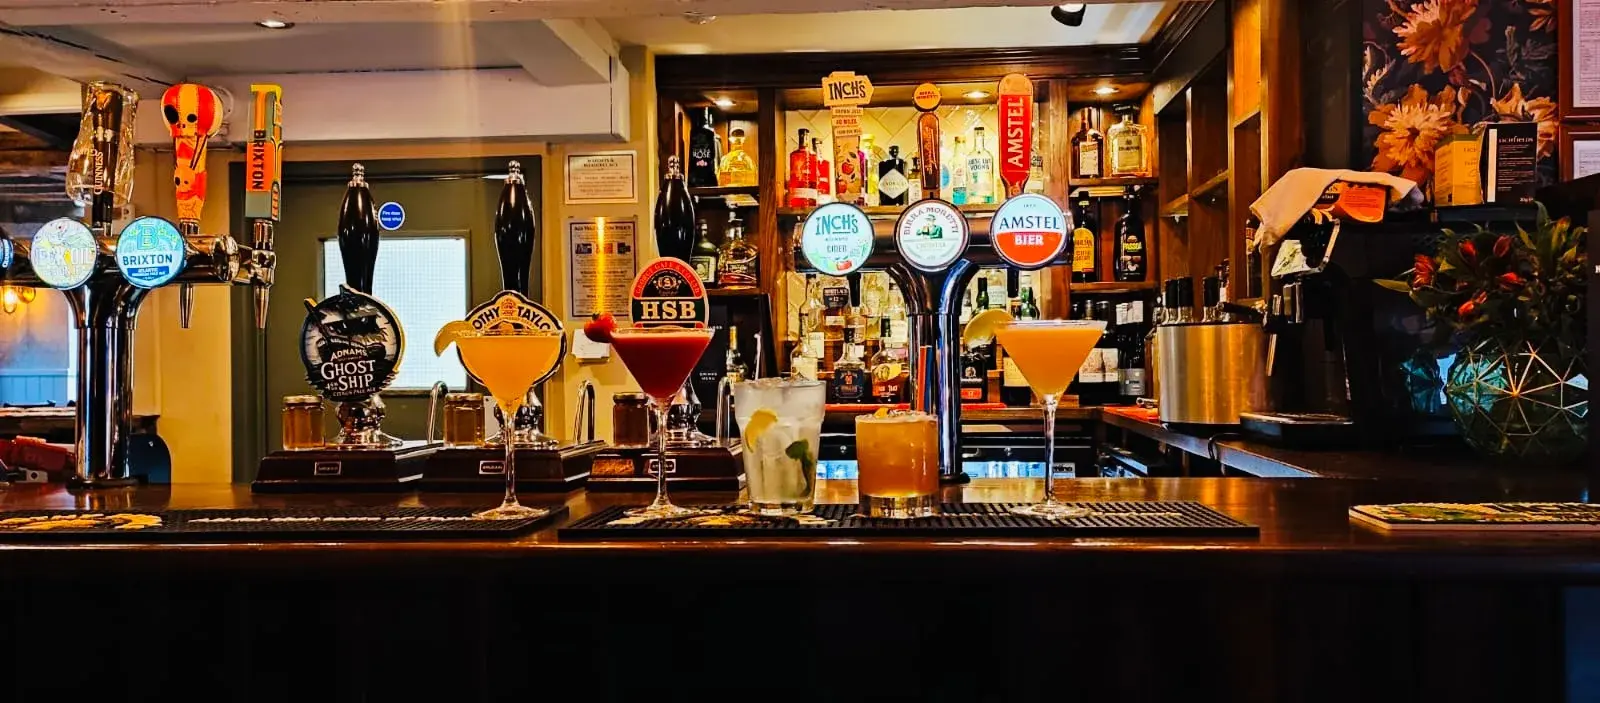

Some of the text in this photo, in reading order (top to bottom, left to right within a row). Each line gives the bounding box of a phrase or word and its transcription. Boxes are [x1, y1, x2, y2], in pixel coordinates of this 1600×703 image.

[1008, 96, 1024, 168] AMSTEL
[252, 130, 266, 189] BRIXTON
[93, 151, 104, 195] GUINNESS
[926, 207, 959, 233] MORETTI
[999, 216, 1060, 229] AMSTEL
[827, 244, 847, 253] CIDER
[1014, 234, 1044, 246] BIER
[122, 254, 173, 266] BRIXTON
[517, 306, 551, 330] TAYLO
[640, 301, 696, 320] HSB
[330, 348, 369, 361] ADNAMS
[321, 360, 376, 380] GHOST
[338, 374, 374, 391] SHIP
